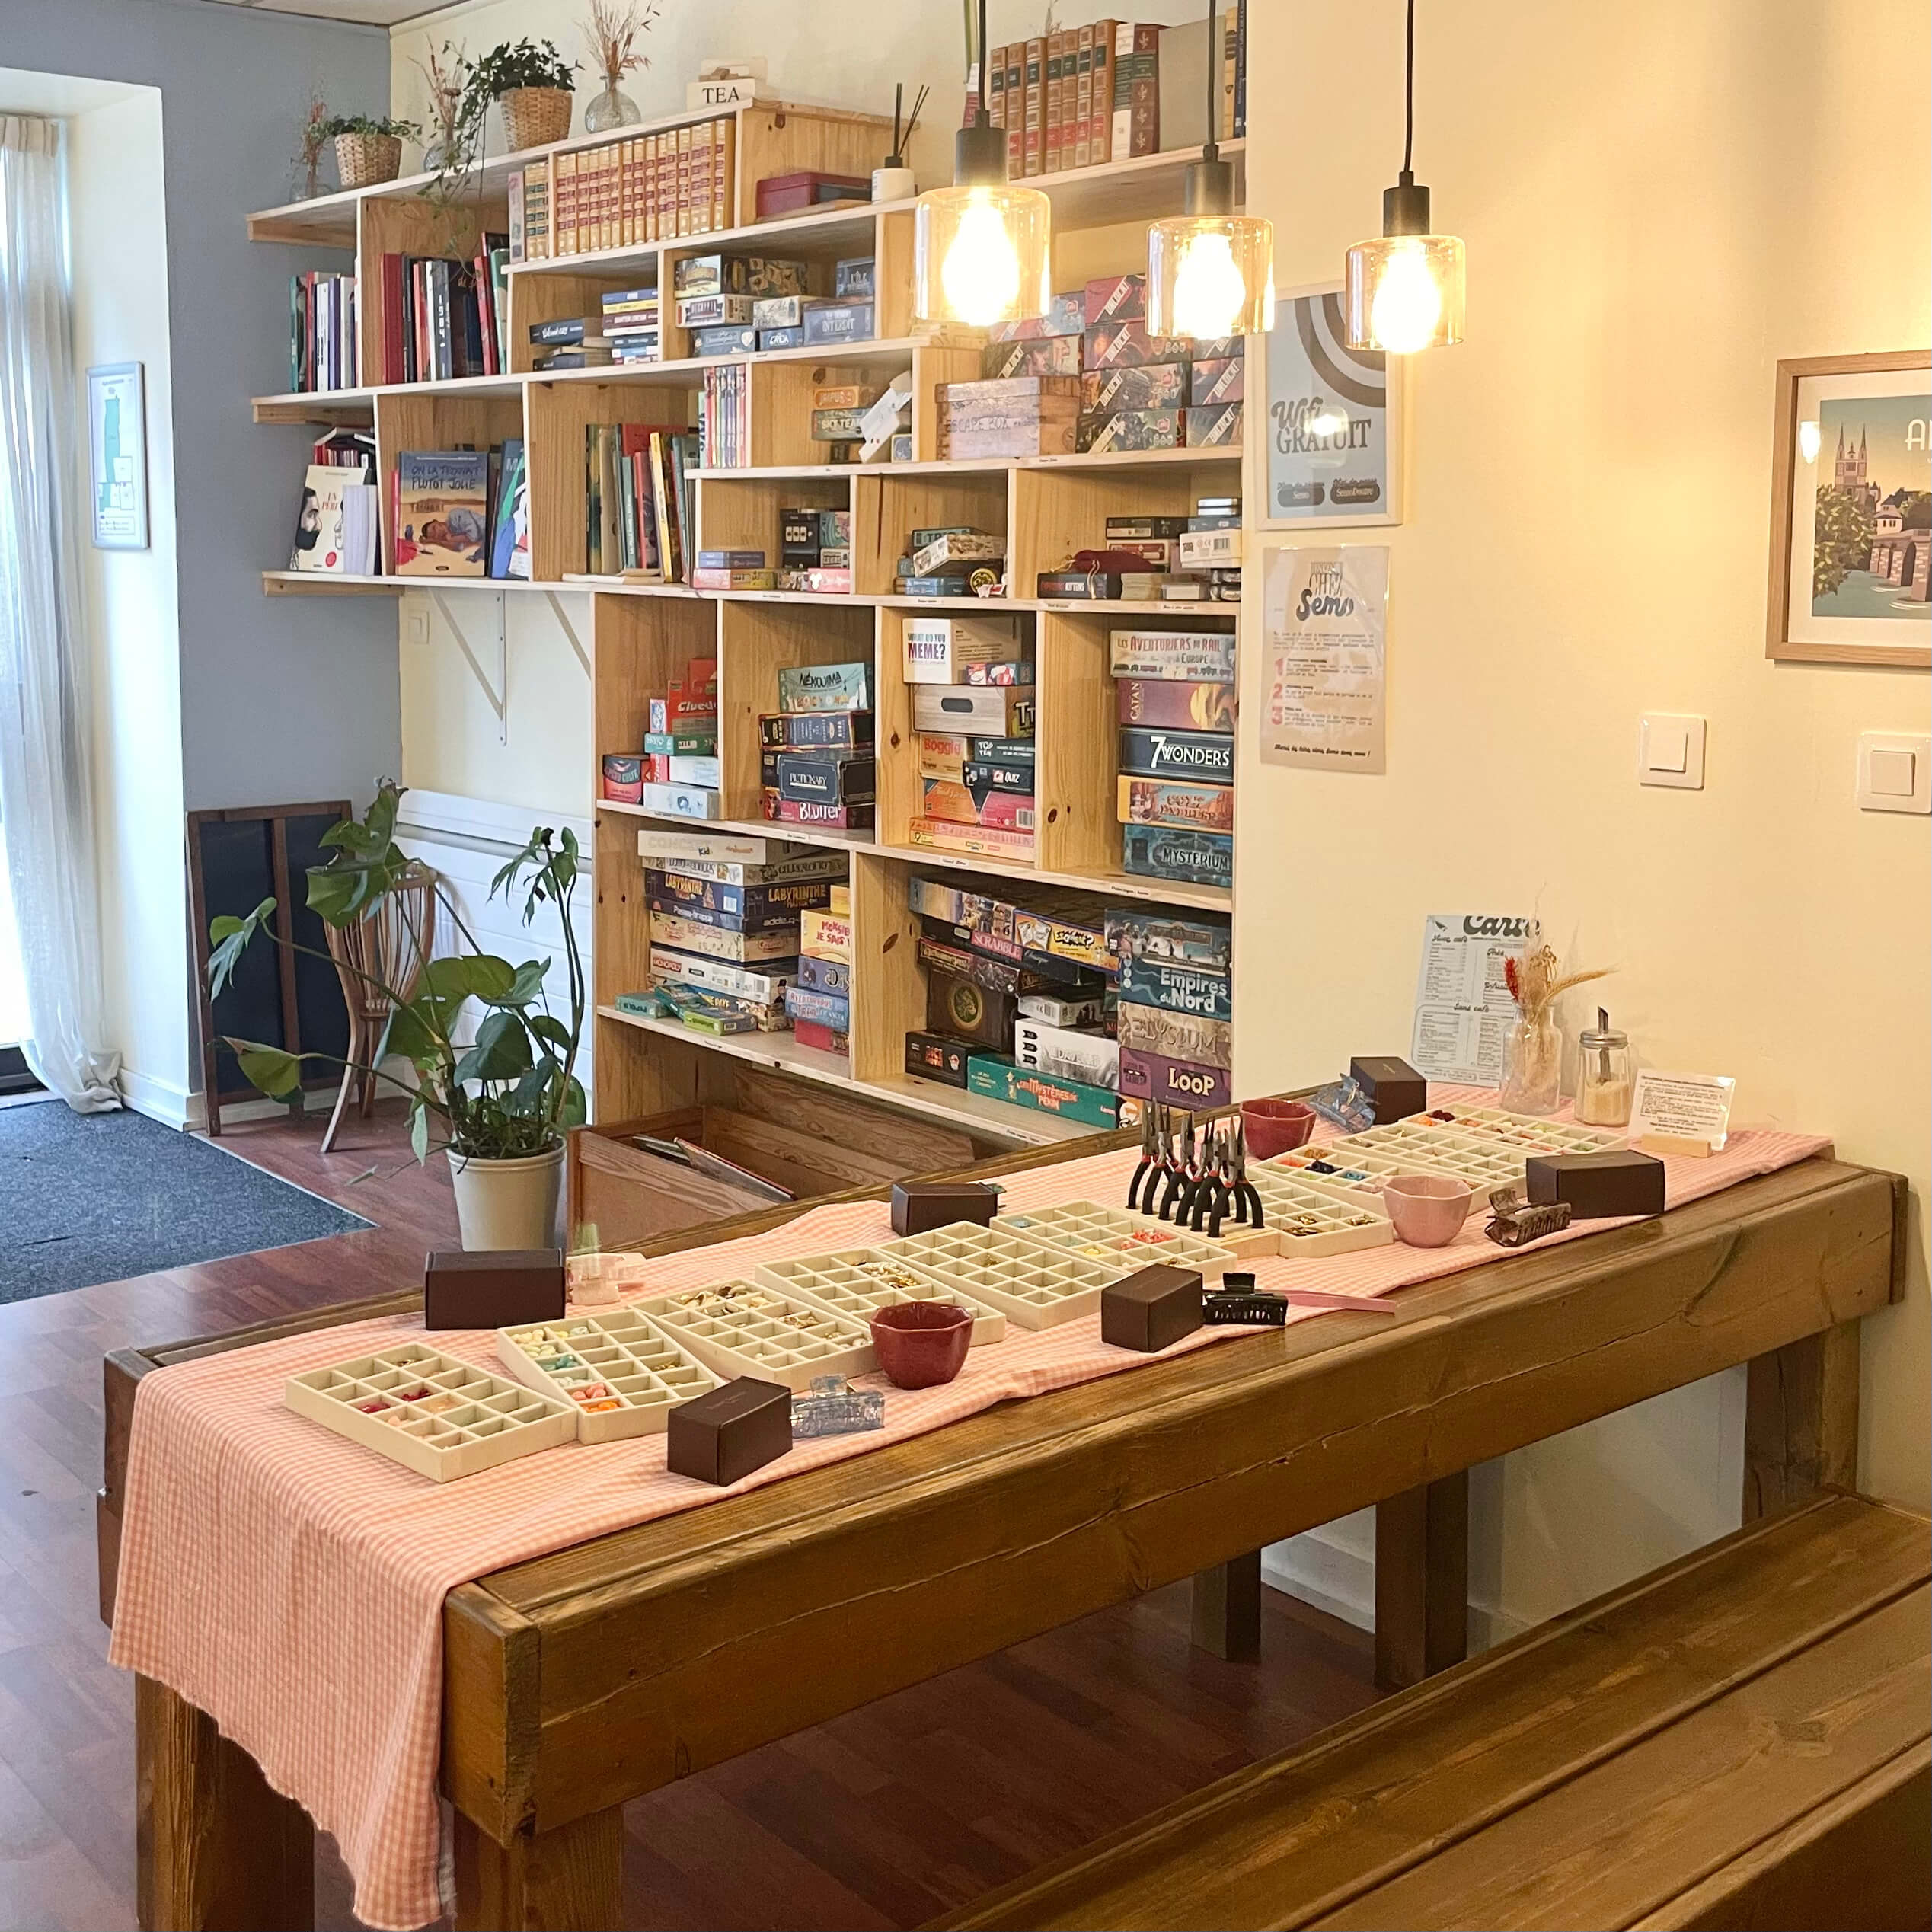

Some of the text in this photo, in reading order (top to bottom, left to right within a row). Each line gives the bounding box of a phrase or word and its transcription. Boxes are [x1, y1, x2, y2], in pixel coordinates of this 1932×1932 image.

[702, 86, 739, 104] TEA
[448, 478, 477, 490] JOLIE
[907, 643, 946, 660] MEME?
[1130, 634, 1191, 653] AVENTURIERS
[1202, 640, 1222, 653] RAIL
[1274, 657, 1285, 677] 1
[1273, 682, 1284, 700] 2
[677, 701, 718, 712] Clued
[1129, 682, 1141, 721] CATAN
[1271, 706, 1284, 726] 3
[1150, 736, 1230, 768] 7 WONDERS
[1161, 845, 1231, 873] MYSTERIUM
[665, 873, 704, 896] LABYRINTHE
[768, 884, 827, 902] LABYRINTHE
[816, 931, 824, 942] JE
[822, 921, 850, 937] MONSIE
[972, 931, 1022, 961] SCRABBLE
[1160, 967, 1228, 998] Empires
[1159, 988, 1216, 1014] du Nord
[1168, 1066, 1216, 1097] LOOP
